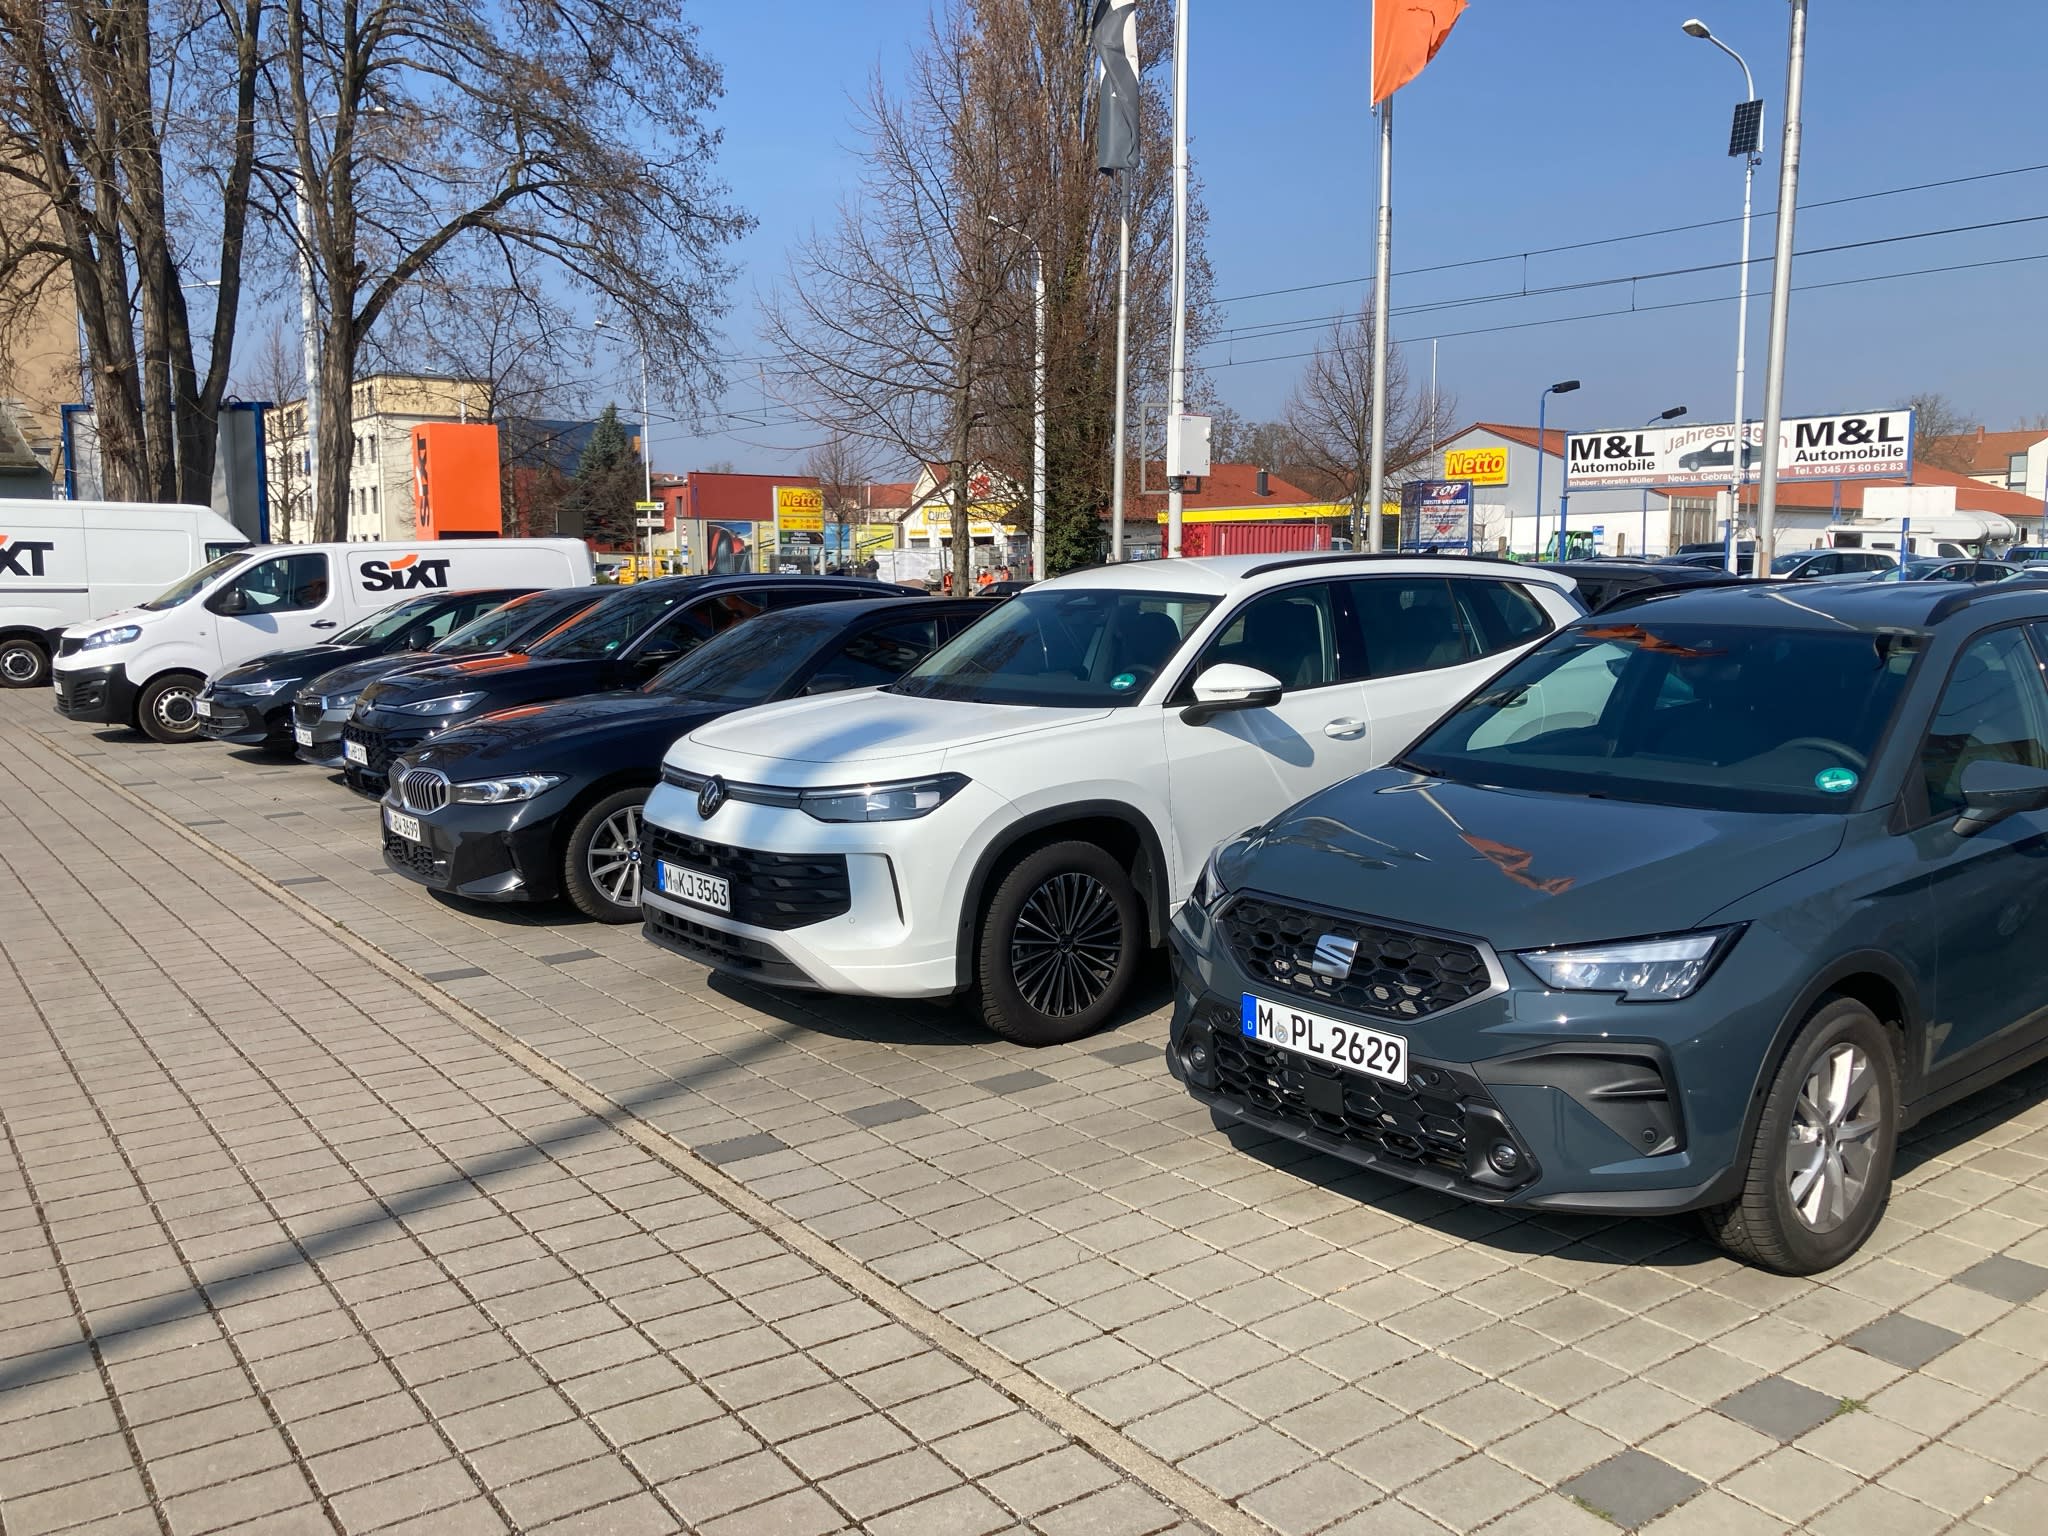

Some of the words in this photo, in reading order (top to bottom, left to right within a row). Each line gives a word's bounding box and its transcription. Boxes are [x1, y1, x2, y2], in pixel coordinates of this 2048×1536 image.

[1665, 424, 1789, 454] Jahreswagn
[1795, 417, 1904, 448] M&L
[1571, 434, 1655, 461] M&L
[1795, 444, 1904, 462] Automobile
[1447, 453, 1505, 475] Netto
[1571, 459, 1656, 474] Automobile
[1794, 466, 1812, 475] Tel.
[1814, 465, 1841, 474] 0345
[1849, 464, 1856, 473] 5
[1858, 463, 1871, 472] 60
[1873, 463, 1887, 472] 62
[1889, 462, 1904, 471] 83
[1431, 484, 1462, 497] TOP
[1569, 477, 1600, 487] Inhaber:
[1601, 477, 1629, 486] Kerstin
[1630, 475, 1655, 484] Müller
[781, 491, 821, 507] Netto
[360, 554, 451, 592] SIXT
[665, 866, 673, 891] M
[679, 871, 694, 897] KJ
[696, 877, 727, 907] 3563
[1247, 1020, 1253, 1030] D
[1258, 1004, 1274, 1039] M
[1291, 1013, 1325, 1053] PL
[1331, 1026, 1401, 1075] 2629
